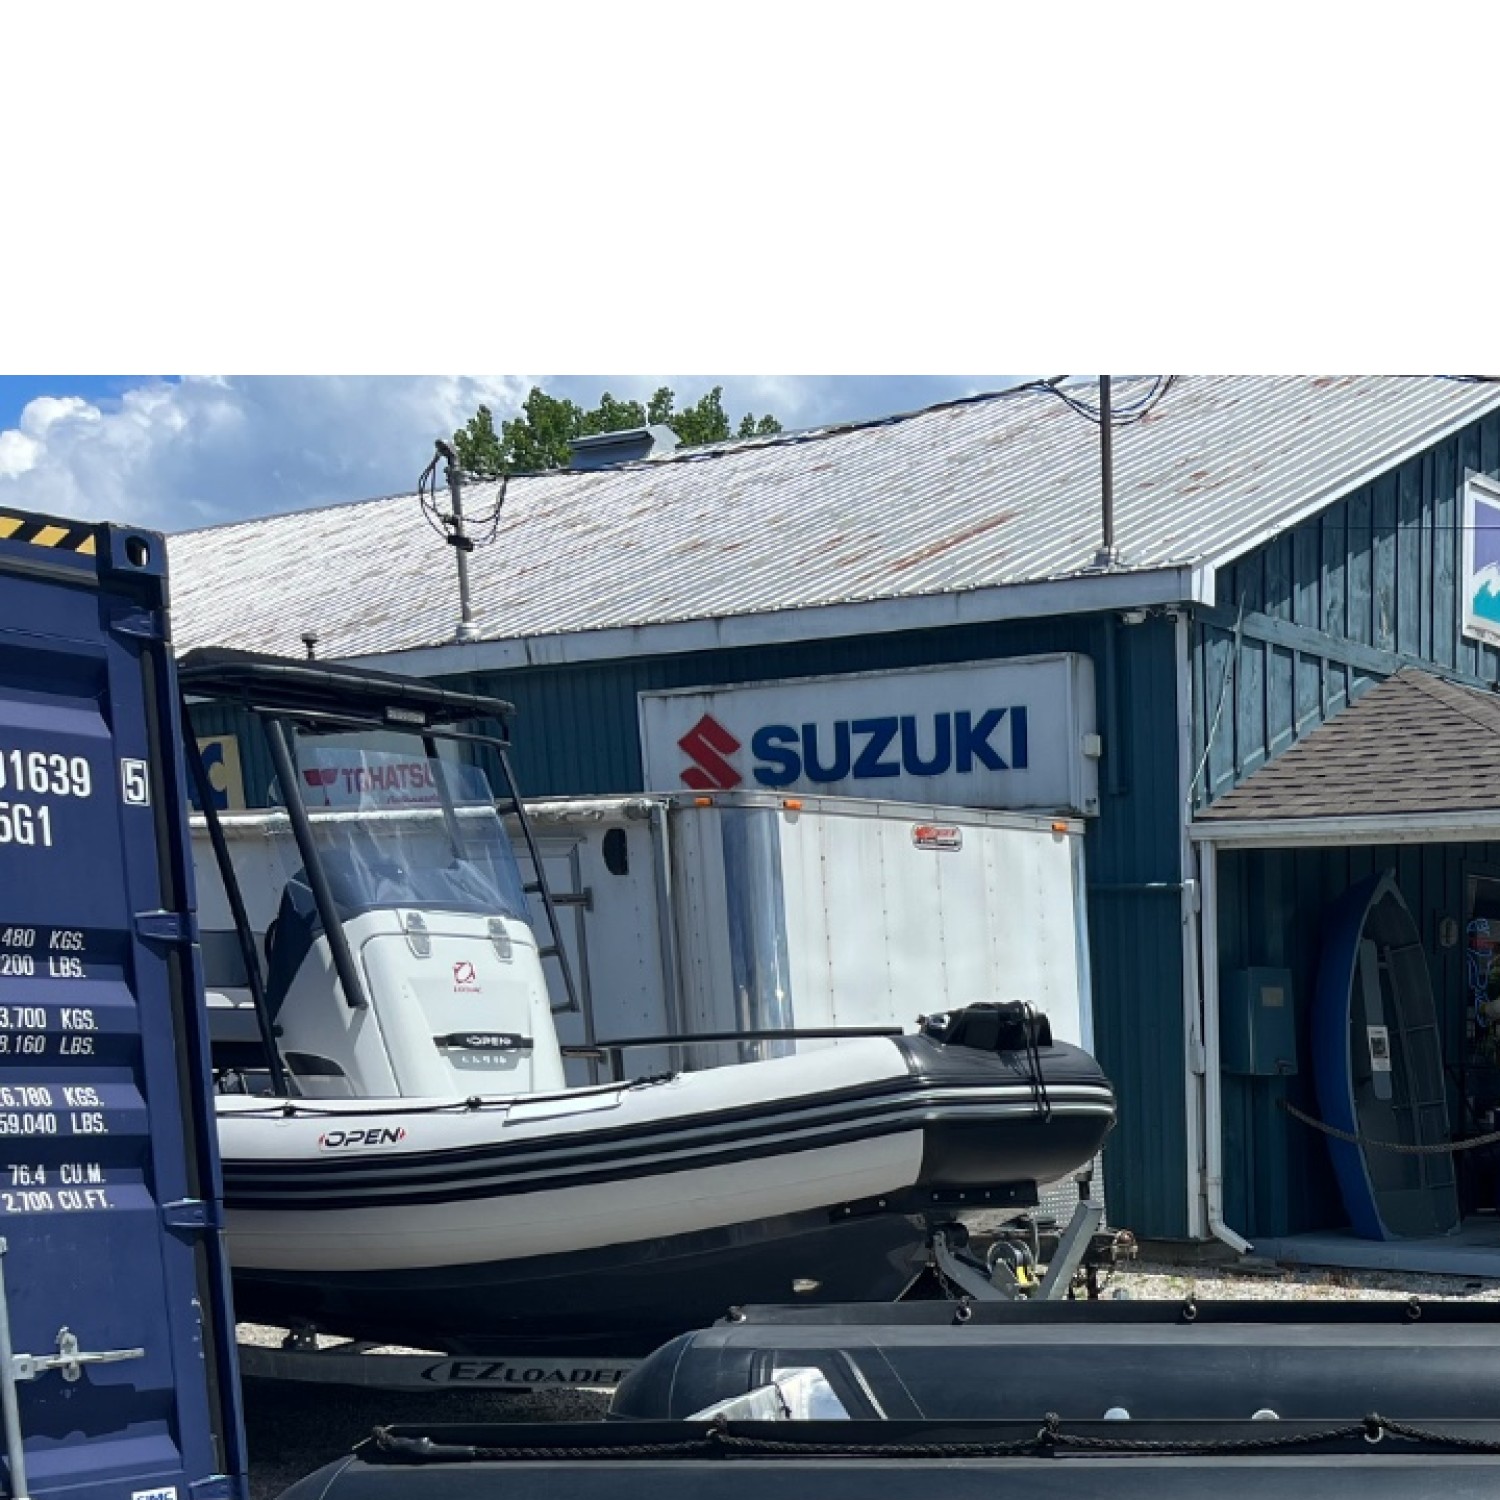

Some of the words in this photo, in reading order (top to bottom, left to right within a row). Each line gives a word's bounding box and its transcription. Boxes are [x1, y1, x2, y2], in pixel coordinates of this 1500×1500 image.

[751, 705, 1028, 787] SUZUKI
[125, 762, 145, 801] 5
[1, 928, 36, 949] 480
[49, 931, 86, 950] KGS.
[49, 956, 87, 978] LBS.
[60, 1008, 98, 1030] KGS.
[60, 1036, 95, 1055] LBS.
[71, 1112, 109, 1134] LBS.
[324, 1126, 402, 1147] OPEN
[8, 1163, 46, 1186] 76.4
